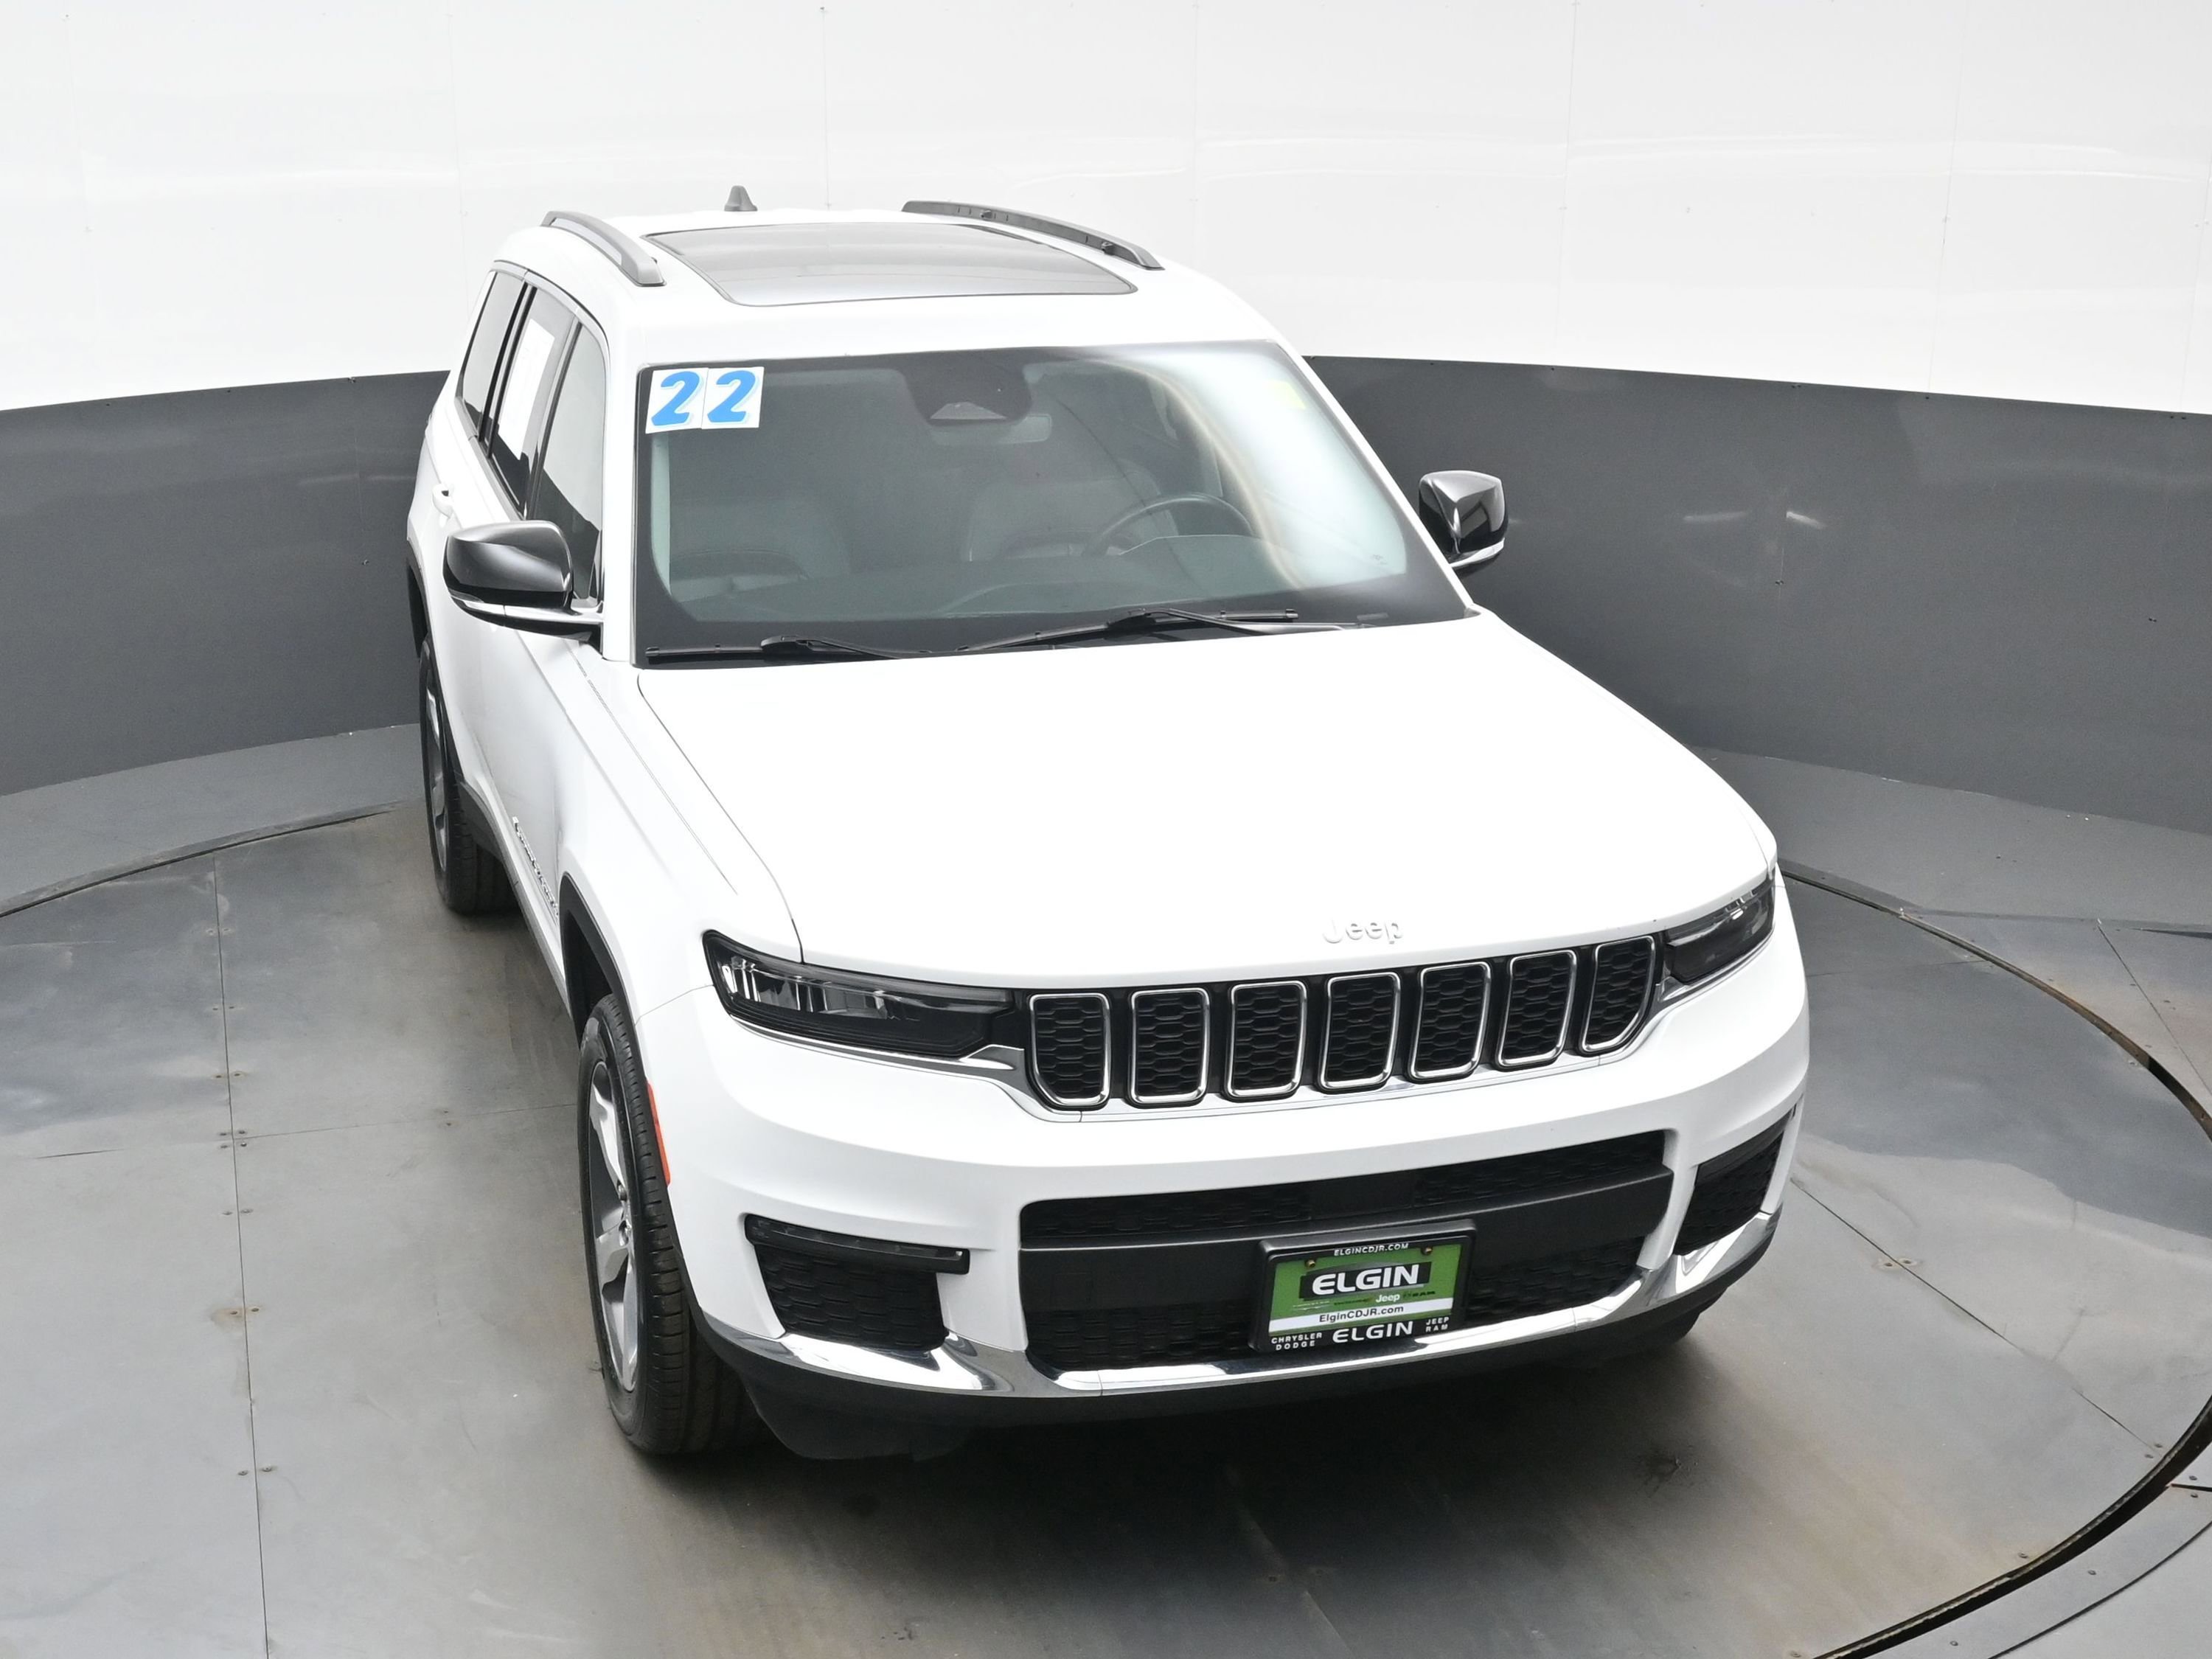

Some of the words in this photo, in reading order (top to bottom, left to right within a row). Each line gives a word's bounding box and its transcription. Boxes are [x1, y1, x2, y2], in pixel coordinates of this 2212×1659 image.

[651, 370, 756, 425] 22
[1322, 917, 1403, 945] Jeep
[1334, 1242, 1409, 1256] ELGINCDJR.COM
[1312, 1264, 1419, 1295] ELGIN
[1375, 1293, 1400, 1303] Jeep
[1319, 1306, 1404, 1323] ElginCDJR.com
[1426, 1316, 1450, 1326] JEEP
[1332, 1321, 1413, 1343] ELGIN
[1426, 1324, 1448, 1332] RAM
[1271, 1332, 1323, 1344] CHRYSLER
[1276, 1340, 1315, 1351] DODGE
